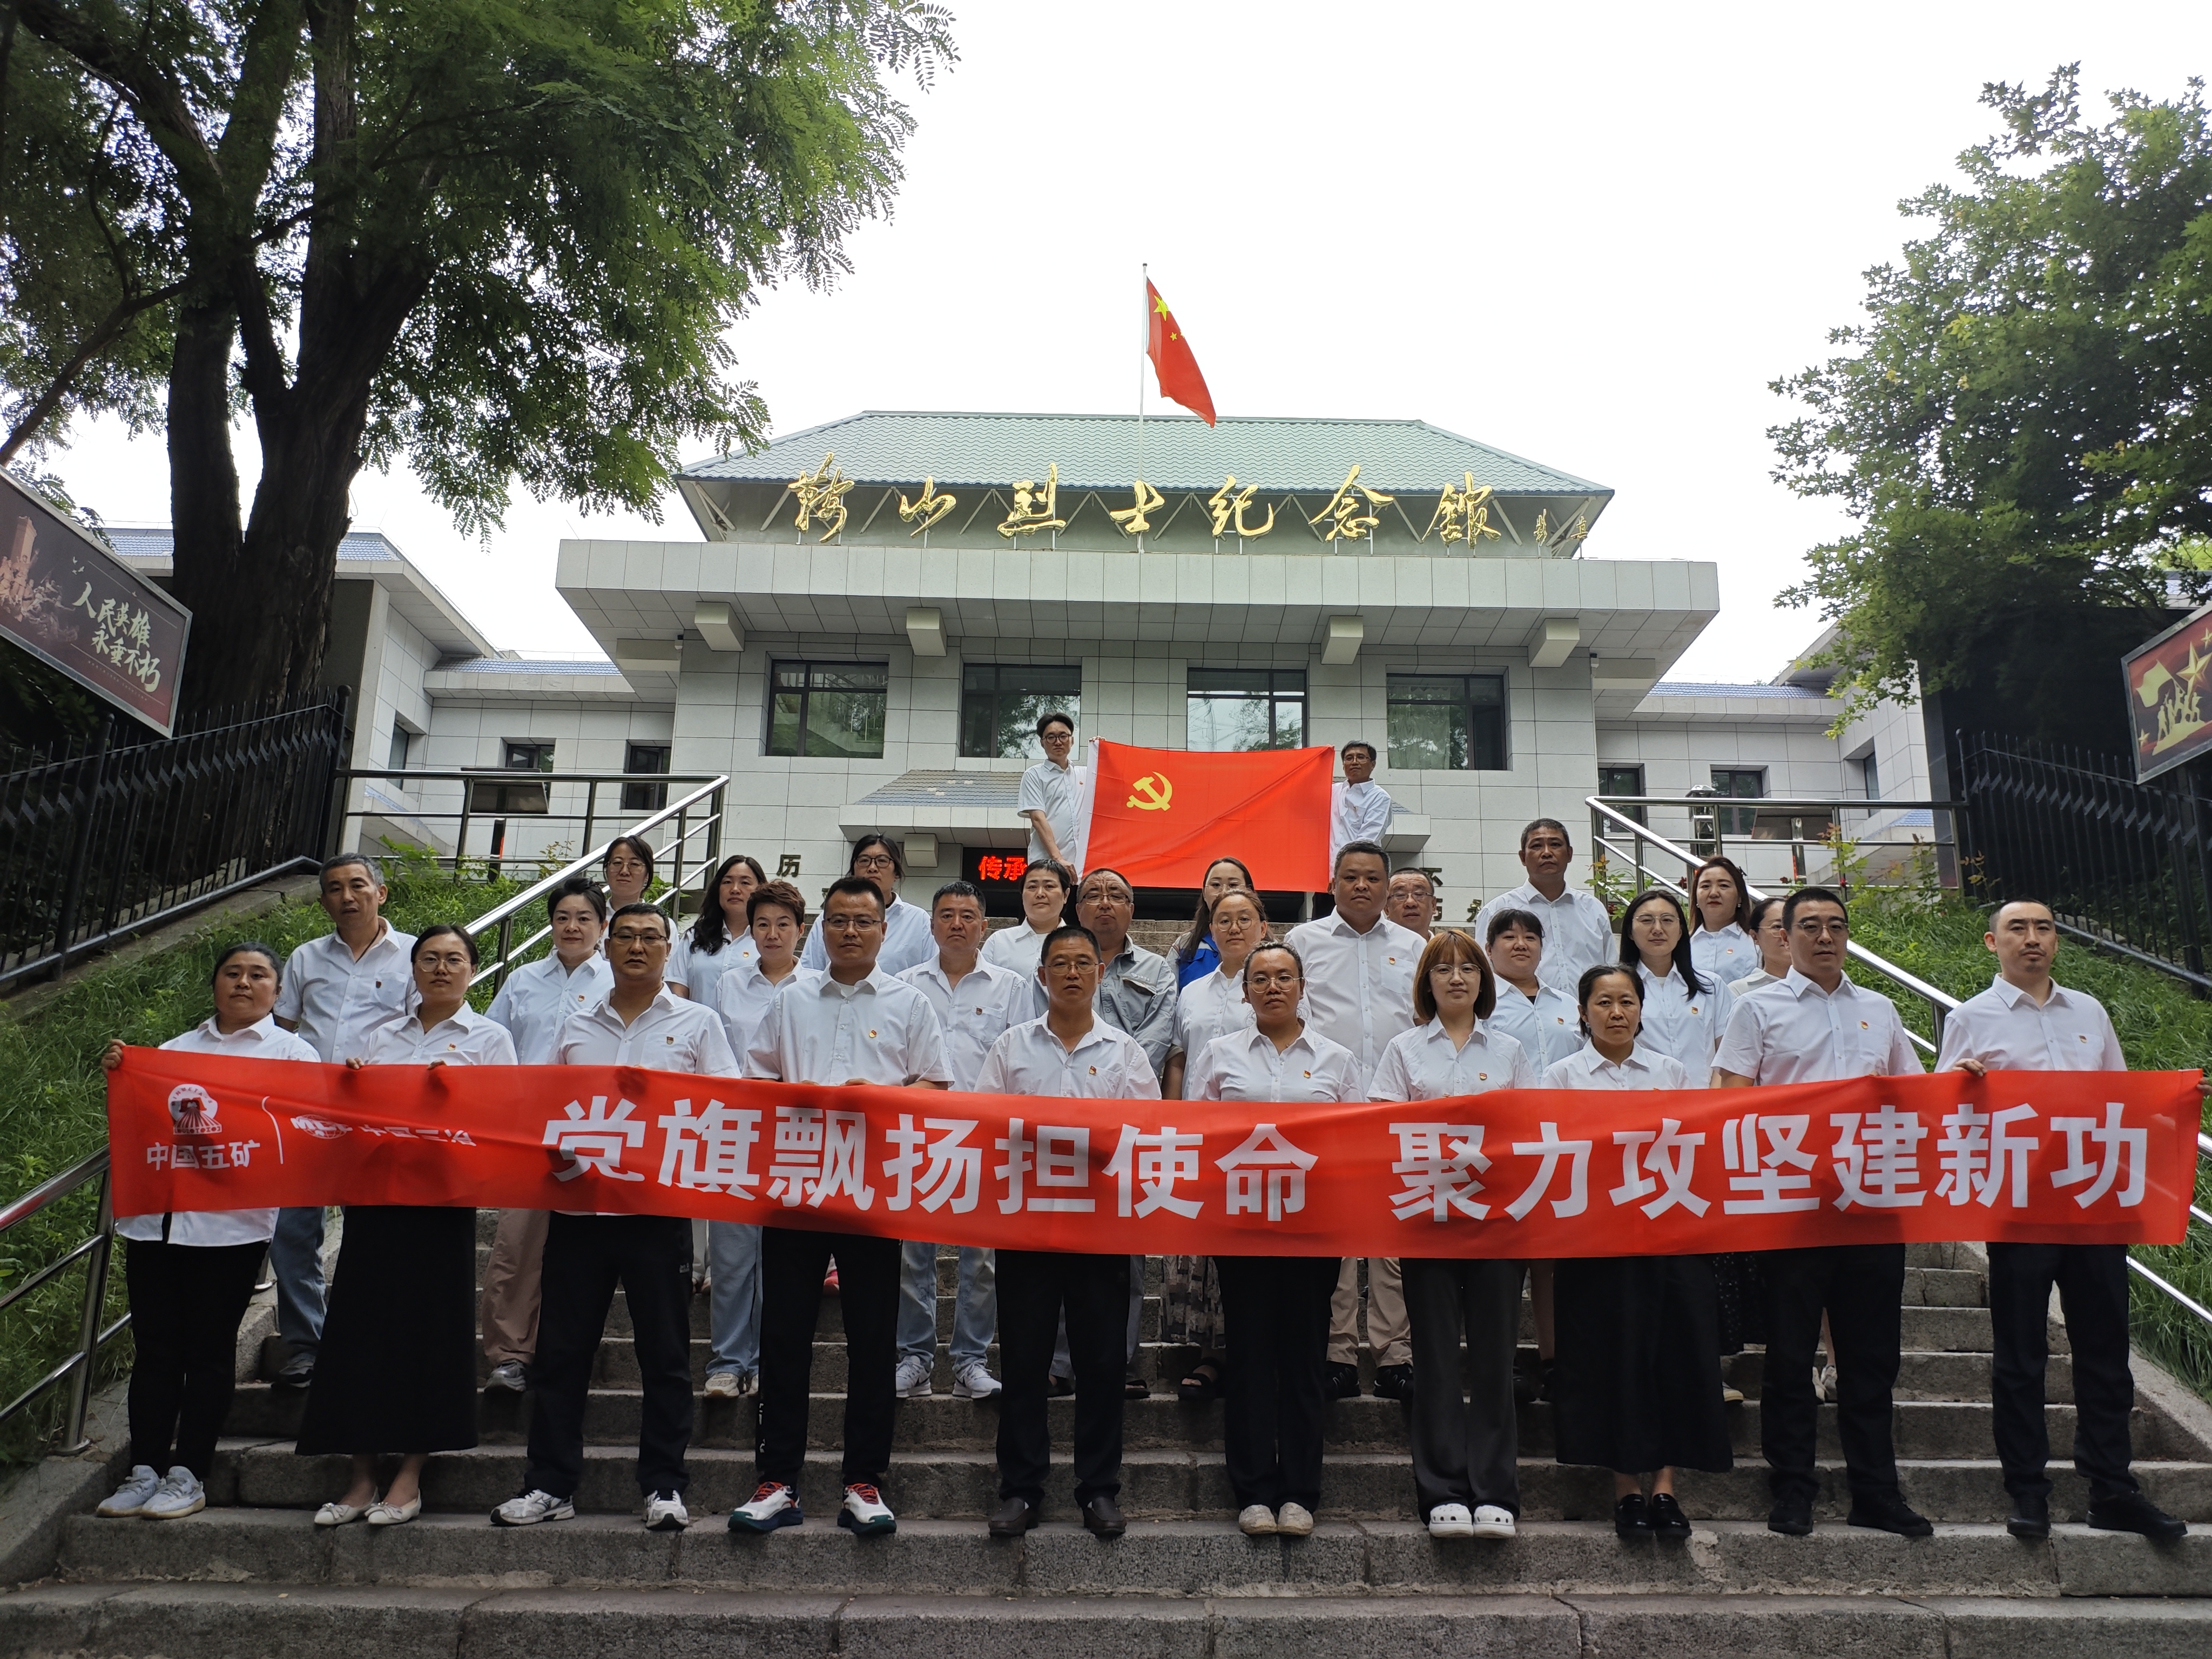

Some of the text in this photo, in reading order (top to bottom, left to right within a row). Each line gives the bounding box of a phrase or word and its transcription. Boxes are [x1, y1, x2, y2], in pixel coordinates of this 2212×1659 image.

[72, 581, 151, 650] 人民英雄
[91, 622, 160, 692] 永垂不朽
[776, 854, 801, 878] 历
[979, 855, 1028, 881] 传承
[147, 1139, 260, 1170] 中国五矿
[542, 1095, 2149, 1223] 党旗飘扬担使命 聚力攻坚建新功
